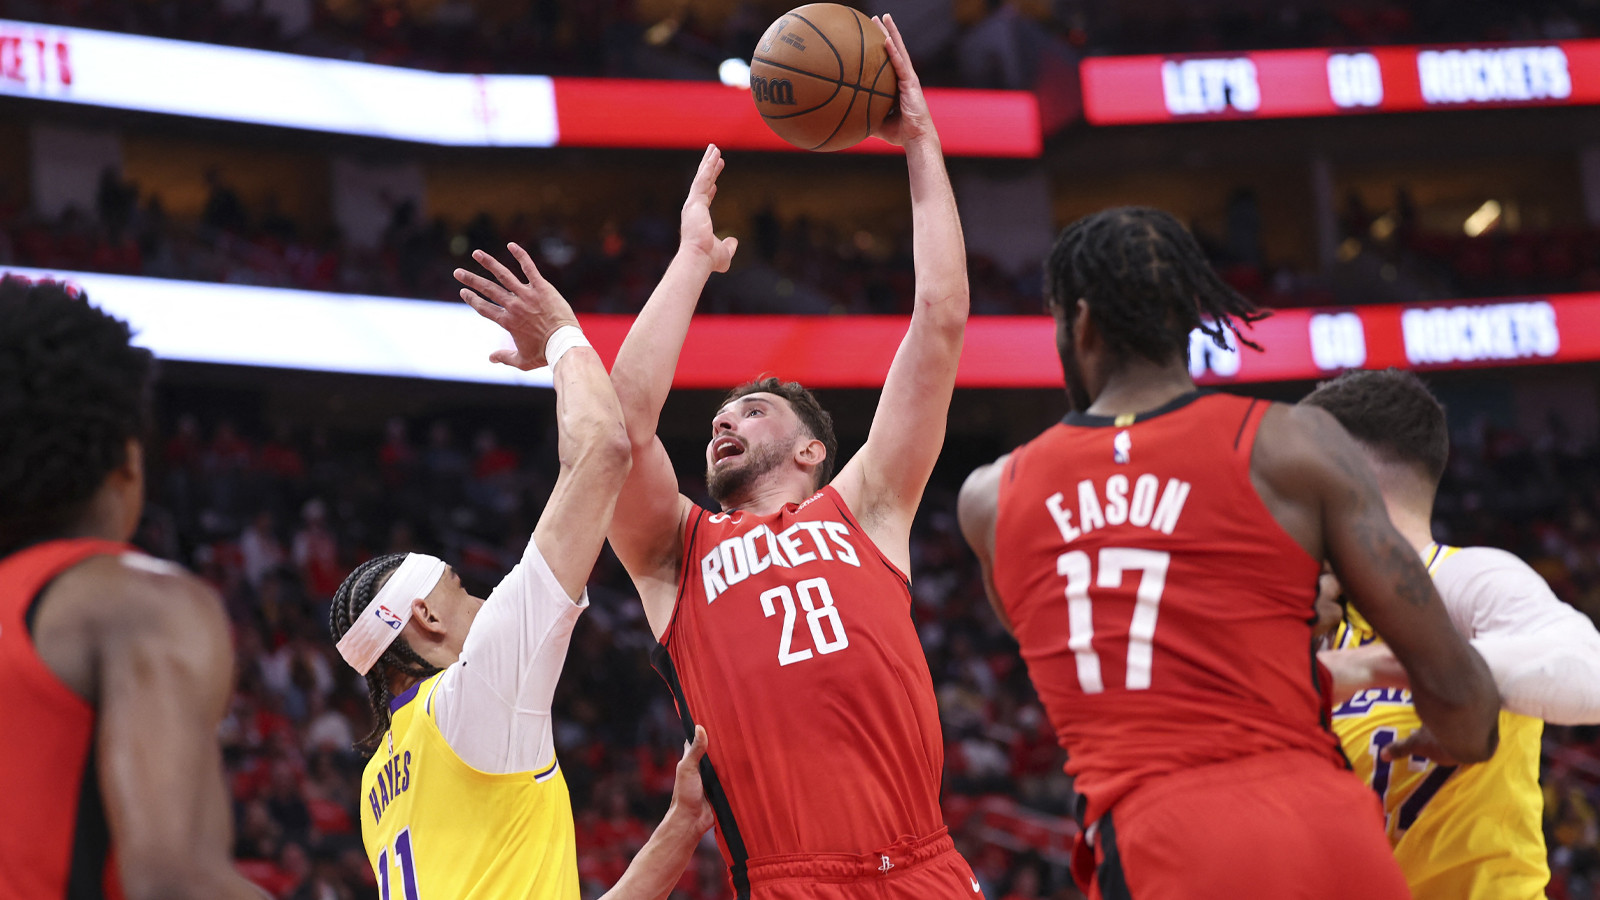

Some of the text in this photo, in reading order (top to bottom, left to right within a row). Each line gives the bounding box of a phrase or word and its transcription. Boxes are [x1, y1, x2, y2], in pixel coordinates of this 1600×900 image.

[1327, 53, 1384, 107] GO
[1417, 46, 1572, 104] ROCKETS
[1309, 312, 1366, 370] GO
[1402, 301, 1560, 365] ROCKETS
[1045, 473, 1191, 543] EASON
[701, 520, 861, 605] ROCKETS
[759, 577, 849, 666] 28
[1057, 547, 1170, 694] 17
[369, 750, 411, 826] HAYES
[378, 824, 421, 900] 11
